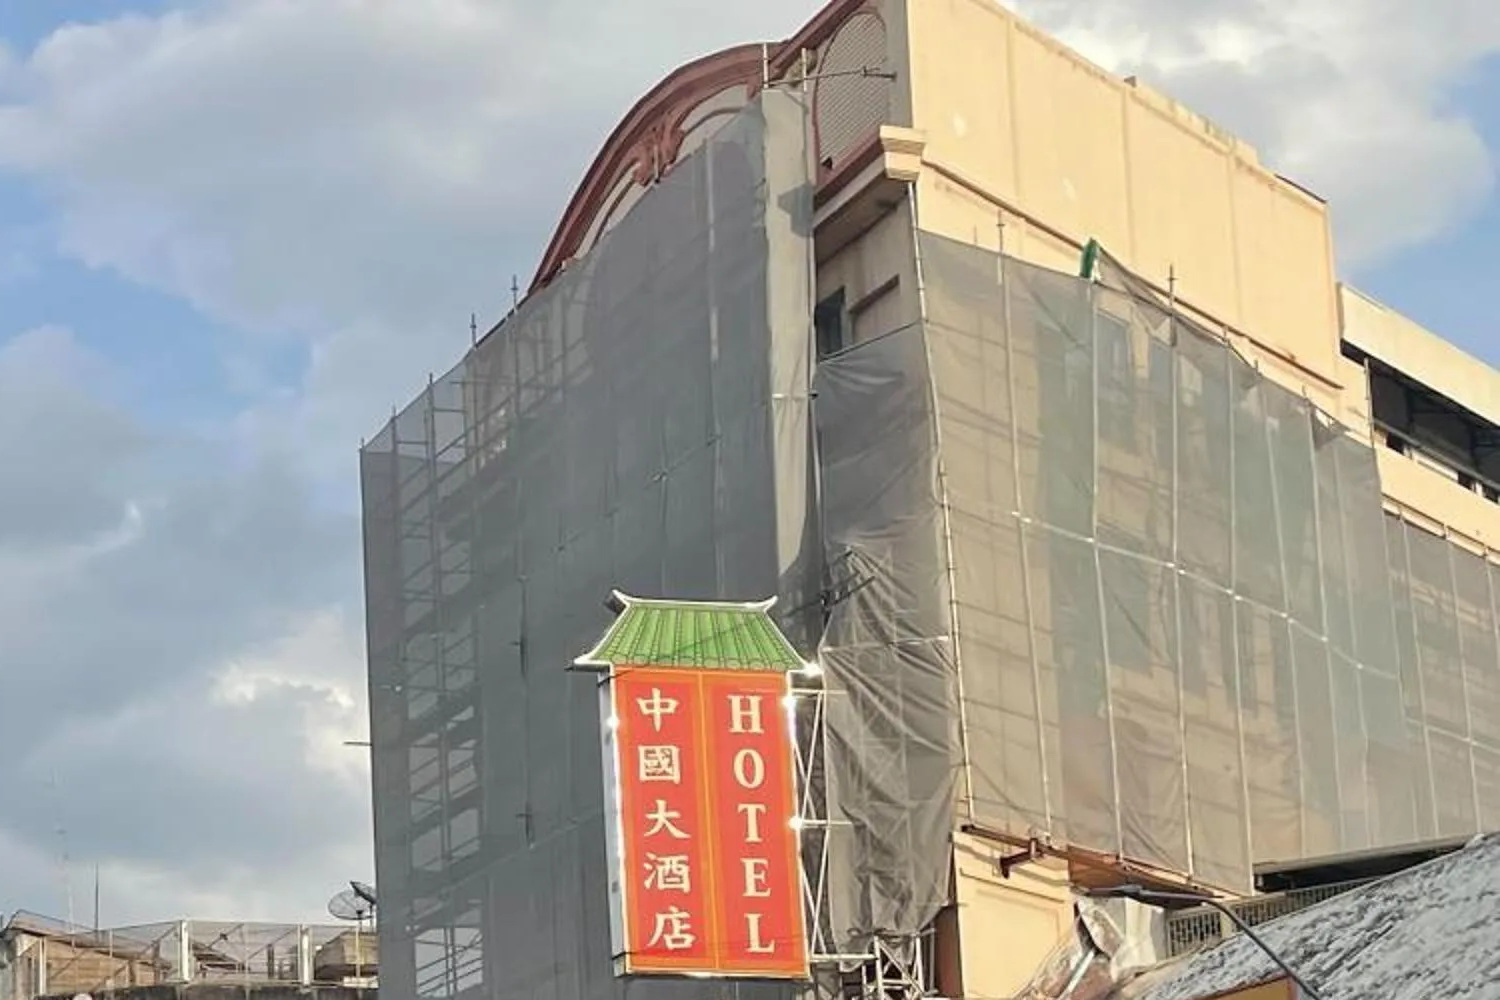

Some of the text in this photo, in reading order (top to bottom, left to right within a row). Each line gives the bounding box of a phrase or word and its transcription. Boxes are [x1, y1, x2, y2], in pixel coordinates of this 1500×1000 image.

[636, 687, 698, 952] 中國大酒店
[728, 694, 776, 955] HOTEL
